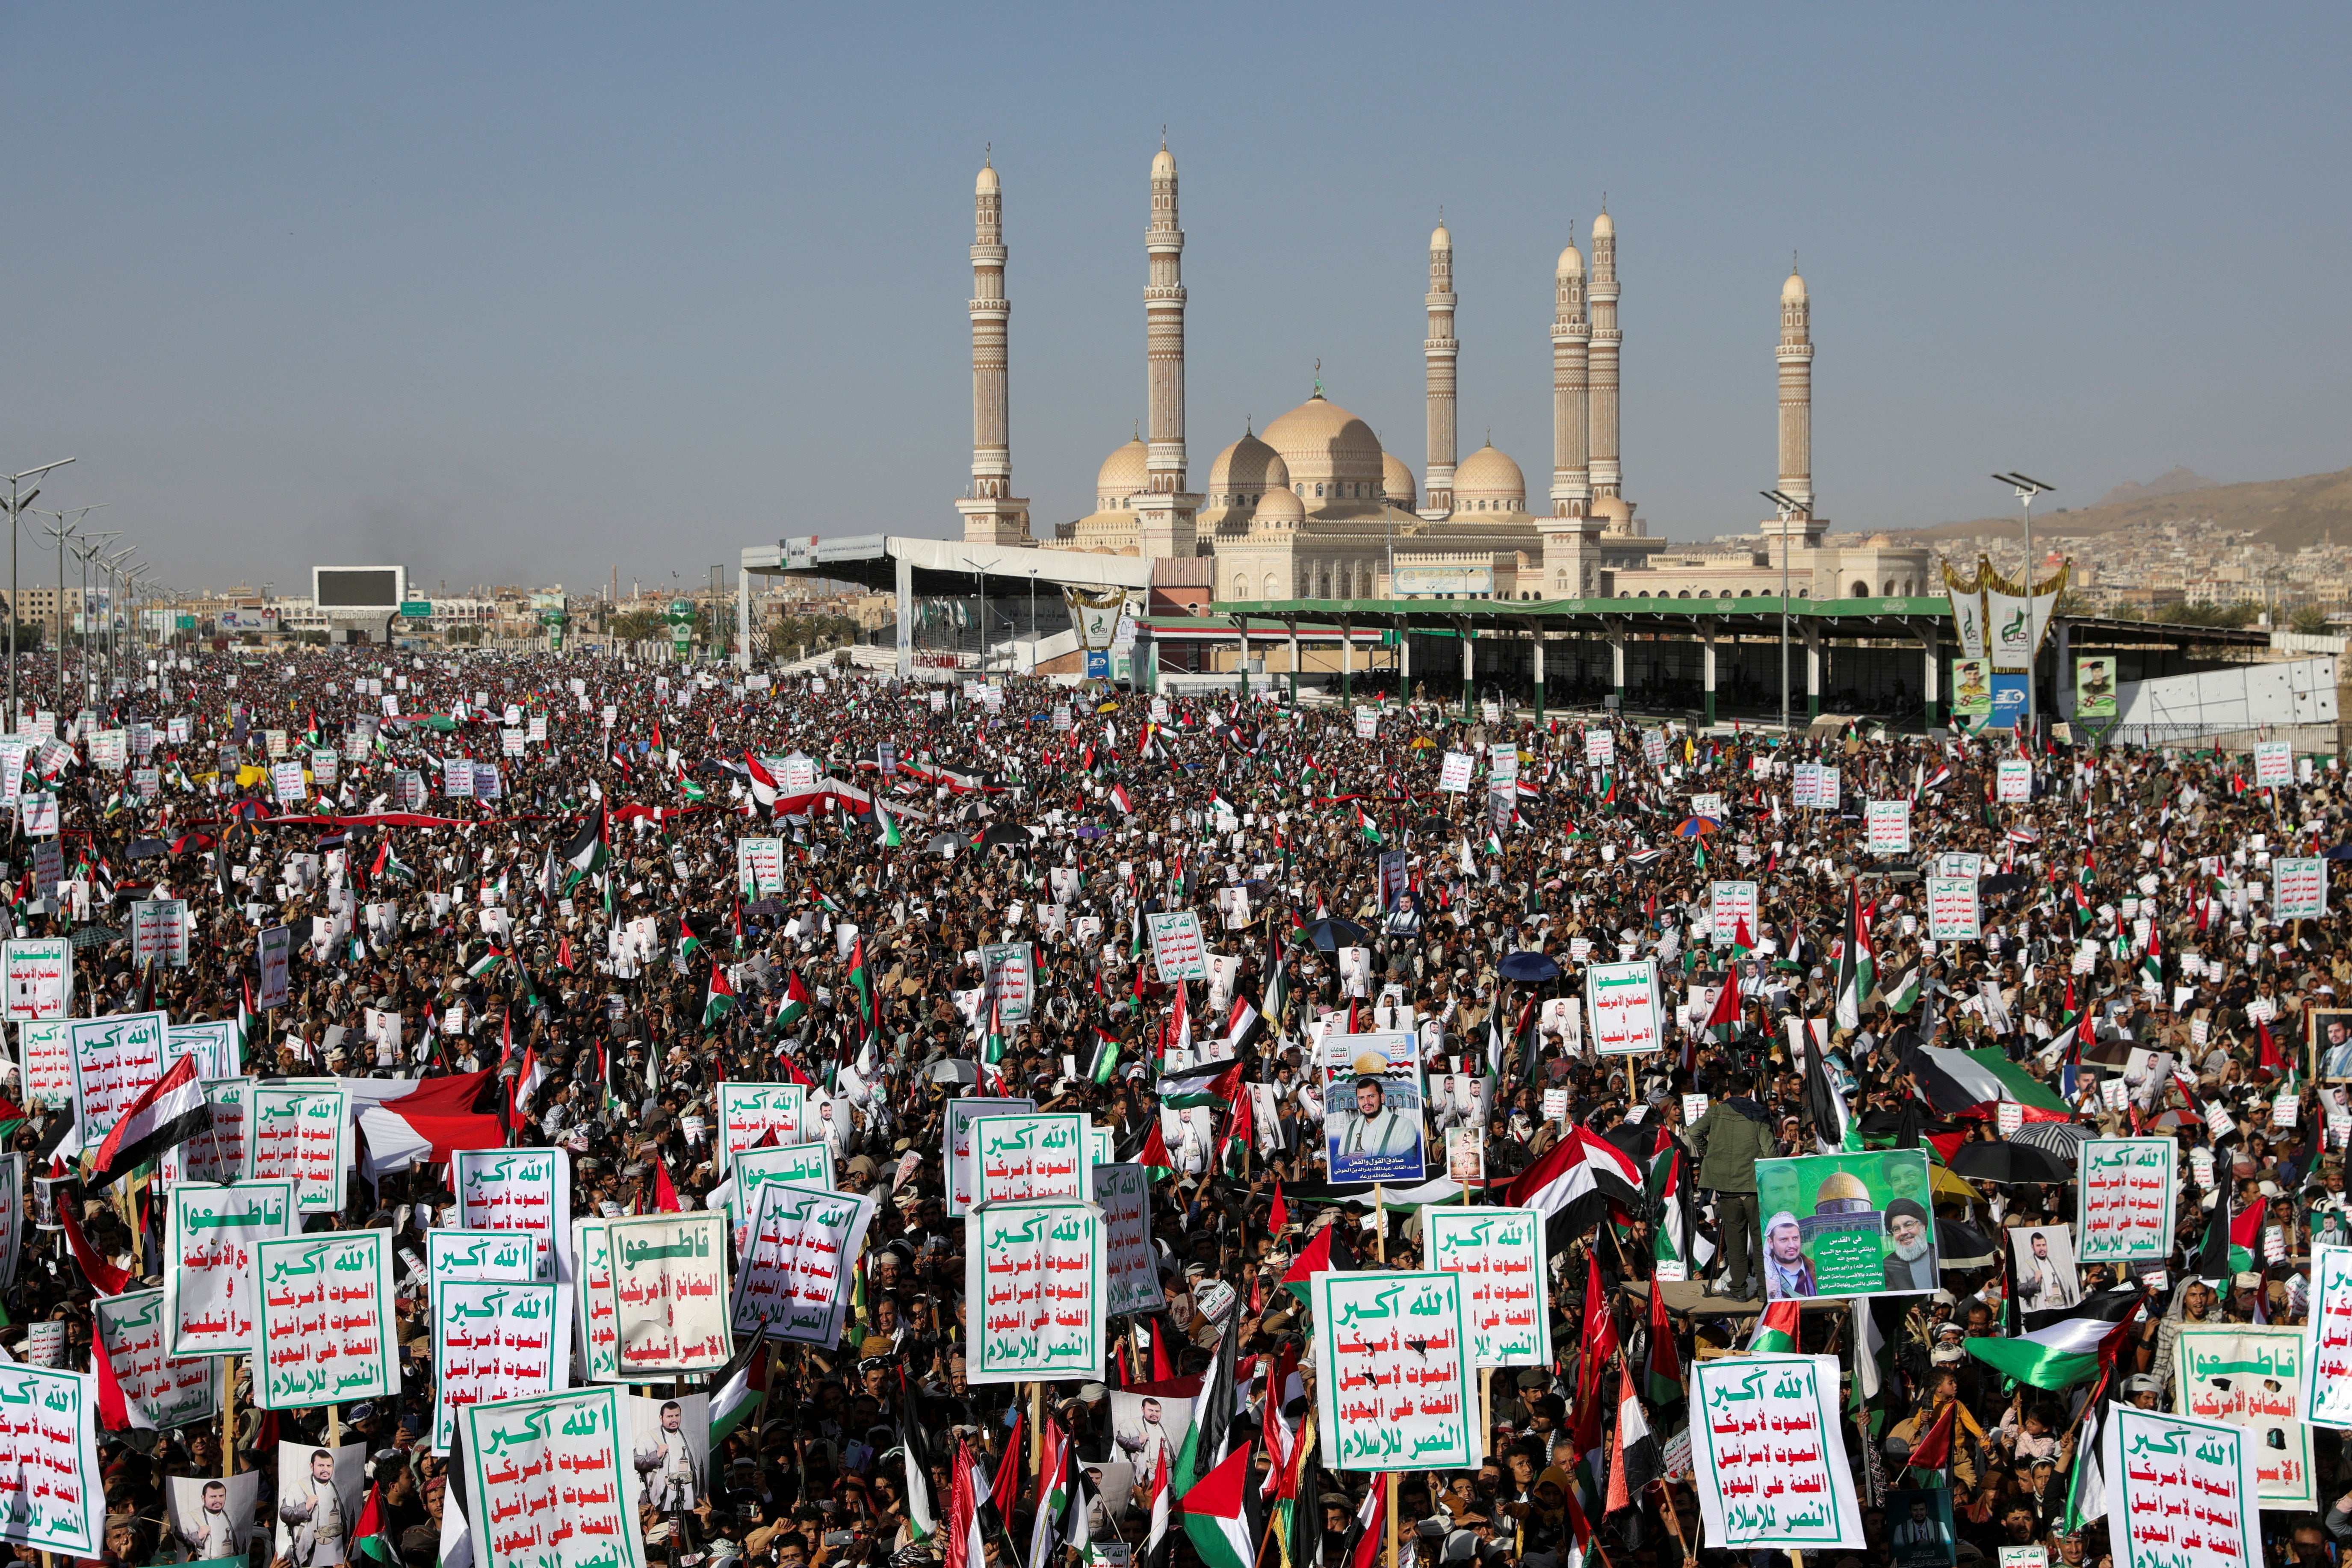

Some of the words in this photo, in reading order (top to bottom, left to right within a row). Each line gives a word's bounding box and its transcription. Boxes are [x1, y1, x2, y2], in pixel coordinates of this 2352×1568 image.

[1157, 915, 1177, 933] أكبر
[1179, 915, 1194, 927] الله
[1179, 930, 1196, 940] الموت
[1182, 942, 1198, 951] الموت
[10, 946, 61, 963] قاطعوا
[10, 965, 36, 980] الأمريكية
[38, 967, 60, 980] البضائع
[1188, 963, 1203, 977] النصر
[1594, 969, 1648, 991] قاطعوا
[1597, 992, 1624, 1010] الأمريكية
[1625, 993, 1649, 1008] البضائع
[1622, 1013, 1626, 1024] و
[1601, 1027, 1653, 1045] الإسرائيلية
[2088, 1145, 2135, 1172] أكبر
[2136, 1147, 2166, 1167] الله
[2088, 1171, 2126, 1190] لأمريكا
[2130, 1175, 2164, 1190] الموت
[764, 1197, 820, 1225] أكبر
[2087, 1194, 2126, 1211] لإسرائيل
[2129, 1197, 2163, 1211] الموت
[183, 1199, 282, 1236] قاطعوا
[817, 1205, 852, 1227] الله
[1051, 1215, 1089, 1241] الله
[2087, 1215, 2114, 1233] اليهود
[2117, 1215, 2132, 1231] على
[2136, 1214, 2162, 1228] اللعنة
[759, 1228, 804, 1247] لأمريكا
[806, 1236, 841, 1253] الموت
[987, 1213, 1049, 1252] أكبر
[1829, 1236, 1850, 1245] القدس
[1853, 1235, 1862, 1244] في
[2127, 1232, 2161, 1255] النصر
[183, 1240, 234, 1272] الأمريكية
[618, 1228, 709, 1271] قاطعوا
[2086, 1236, 2123, 1256] للإسلام
[266, 1244, 331, 1285] أكبر
[334, 1246, 374, 1271] الله
[753, 1253, 798, 1276] لإسرائيل
[800, 1261, 837, 1279] الموت
[988, 1250, 1041, 1276] لأمريكا
[1045, 1253, 1088, 1273] الموت
[226, 1277, 233, 1298] و
[267, 1281, 325, 1309] لأمريكا
[329, 1282, 374, 1304] الموت
[618, 1270, 671, 1307] الأمريكية
[676, 1273, 718, 1302] البضائع
[747, 1279, 780, 1298] اليهود
[781, 1283, 799, 1299] على
[803, 1284, 833, 1302] اللعنة
[988, 1282, 1041, 1306] لإسرائيل
[1045, 1282, 1088, 1302] الموت
[1336, 1282, 1405, 1329] أكبر
[1410, 1285, 1453, 1316] الله
[269, 1313, 326, 1340] لإسرائيل
[331, 1311, 376, 1332] الموت
[667, 1304, 674, 1327] و
[739, 1302, 783, 1331] للإسلام
[788, 1308, 827, 1332] النصر
[987, 1311, 1025, 1333] اليهود
[1030, 1309, 1050, 1331] على
[1055, 1308, 1088, 1326] اللعنة
[270, 1343, 310, 1368] اليهود
[316, 1341, 337, 1364] على
[343, 1338, 378, 1356] اللعنة
[623, 1335, 725, 1366] الإسرائيلية
[987, 1337, 1039, 1365] للإسلام
[1043, 1332, 1088, 1363] النصر
[1406, 1362, 1457, 1388] الموت
[2189, 1347, 2295, 1382] قاطعوا
[272, 1369, 326, 1400] للإسلام
[332, 1361, 380, 1395] النصر
[1709, 1367, 1767, 1411] أكبر
[1774, 1370, 1813, 1399] الله
[1340, 1397, 1384, 1424] اليهود
[1389, 1397, 1414, 1422] على
[1420, 1394, 1459, 1415] اللعنة
[2192, 1386, 2246, 1419] الأمريكية
[2248, 1393, 2296, 1421] البضائع
[562, 1403, 609, 1435] الله
[1712, 1407, 1767, 1436] لأمريكا
[1771, 1412, 1816, 1435] الموت
[482, 1406, 556, 1457] أكبر
[1409, 1422, 1461, 1460] النصر
[2127, 1426, 2191, 1459] أكبر
[1344, 1428, 1402, 1463] للإسلام
[1717, 1444, 1770, 1469] لإسرائيل
[1775, 1443, 1822, 1467] الموت
[2195, 1436, 2234, 1466] الله
[485, 1447, 553, 1485] لأمريكا
[558, 1448, 612, 1474] الموت
[1722, 1475, 1758, 1498] اليهود
[1790, 1474, 1826, 1493] اللعنة
[2129, 1462, 2187, 1487] لأمريكا
[2192, 1475, 2235, 1498] الموت
[563, 1483, 615, 1508] الموت
[1763, 1476, 1784, 1498] على
[491, 1485, 558, 1524] لإسرائيل
[1784, 1500, 1831, 1533] النصر
[2131, 1493, 2189, 1521] لإسرائيل
[579, 1515, 620, 1535] اللعنة
[1728, 1505, 1776, 1535] للإسلام
[2194, 1505, 2238, 1529] الموت
[494, 1524, 542, 1556] اليهود
[548, 1518, 573, 1547] على
[2133, 1525, 2175, 1546] اليهود
[2181, 1530, 2201, 1549] على
[2207, 1533, 2241, 1558] اللعنة
